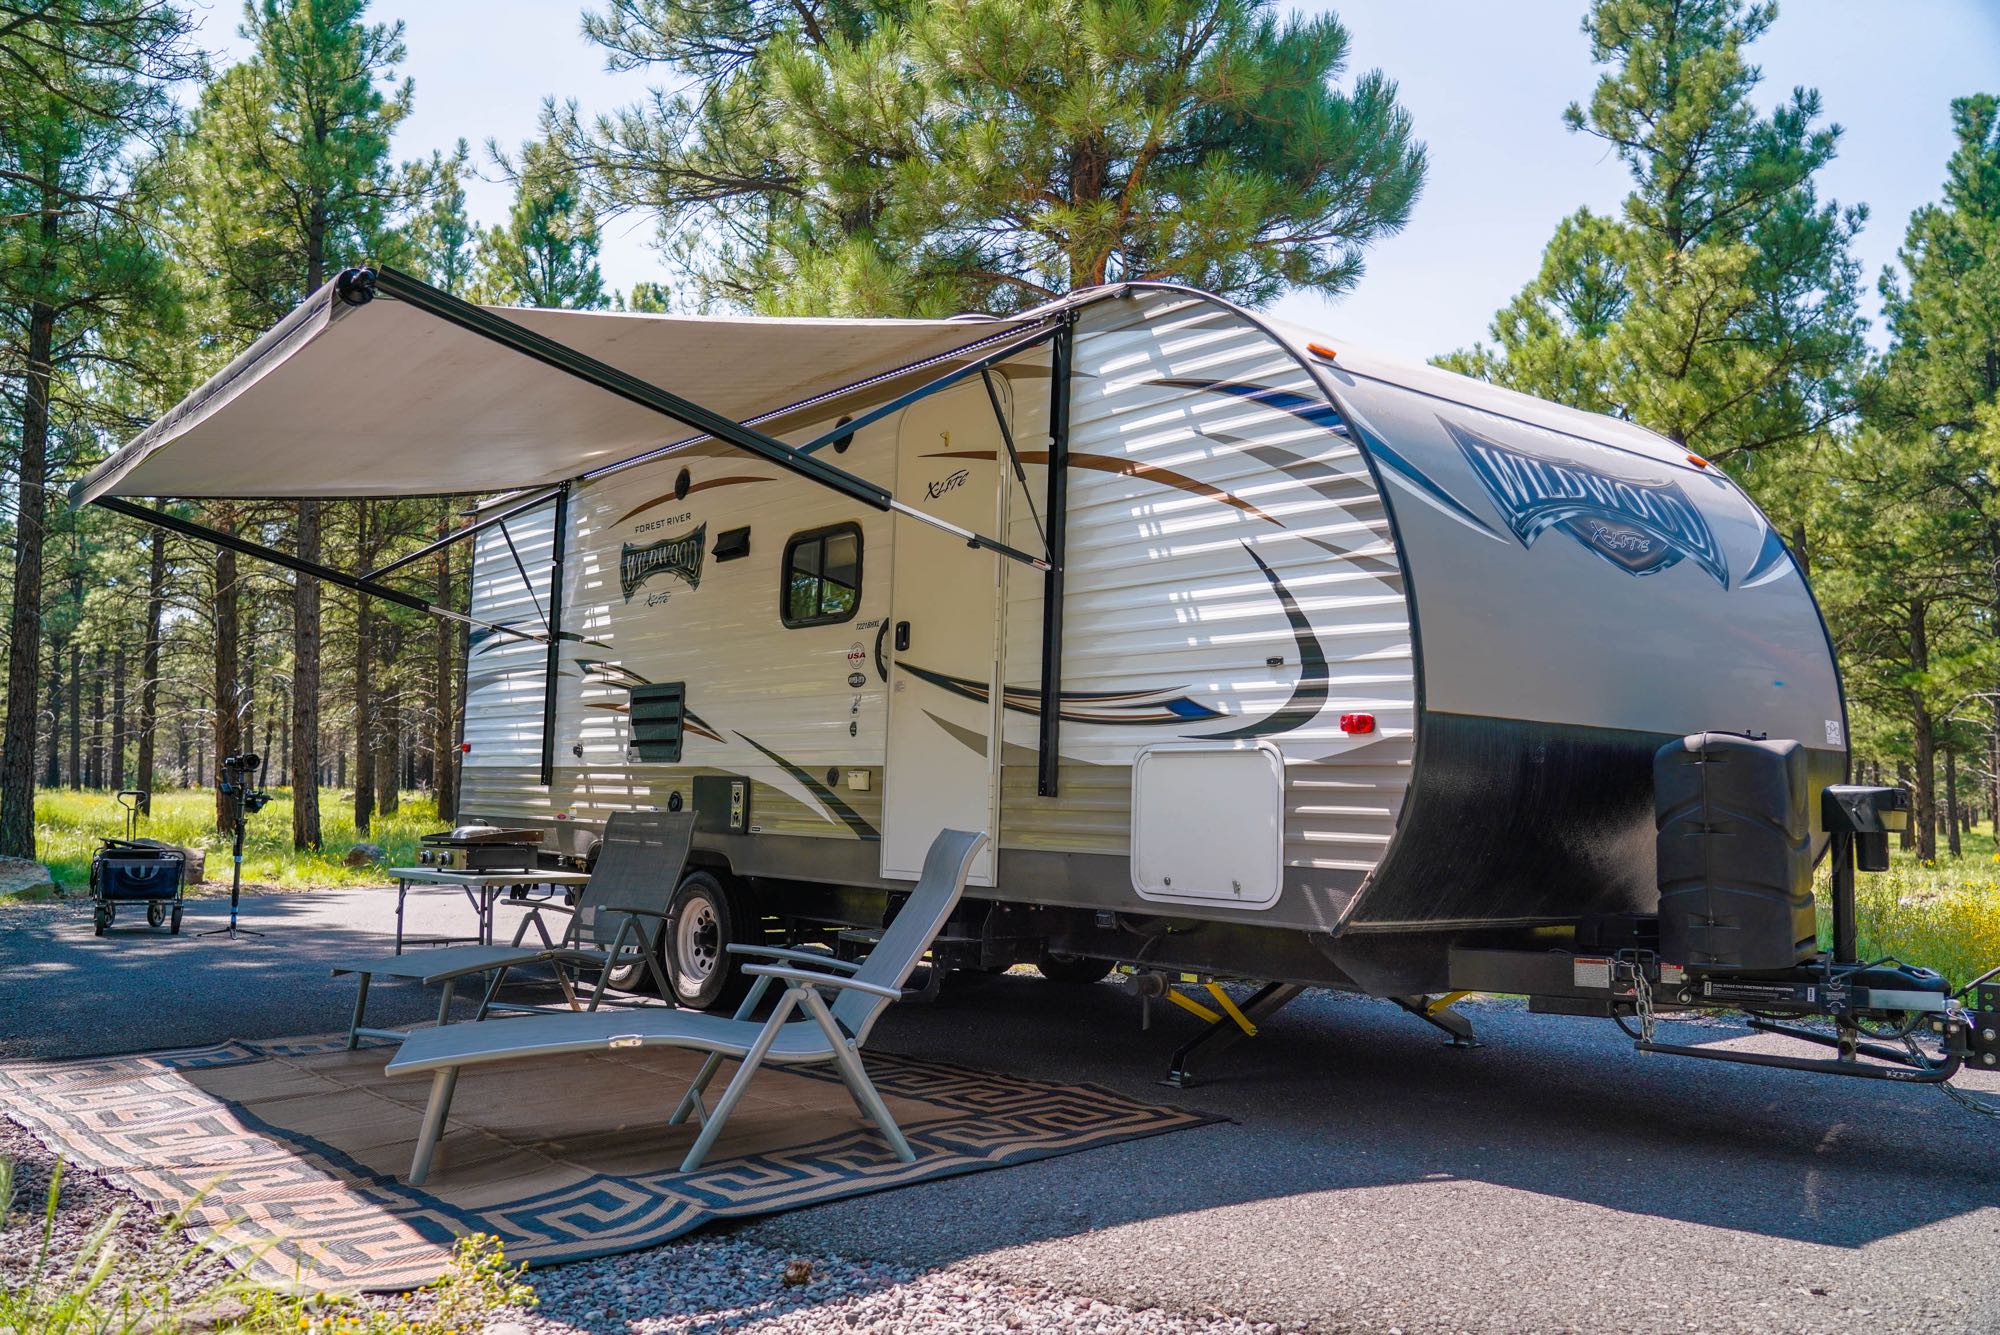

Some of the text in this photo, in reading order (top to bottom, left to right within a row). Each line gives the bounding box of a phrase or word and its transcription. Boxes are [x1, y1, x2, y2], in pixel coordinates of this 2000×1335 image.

[923, 469, 970, 502] X-LITE
[1472, 444, 1705, 549] WILDWOOD
[634, 512, 692, 533] FOREST RIVER
[1589, 520, 1650, 553] X-LITE
[626, 540, 697, 585] WILDWOOD
